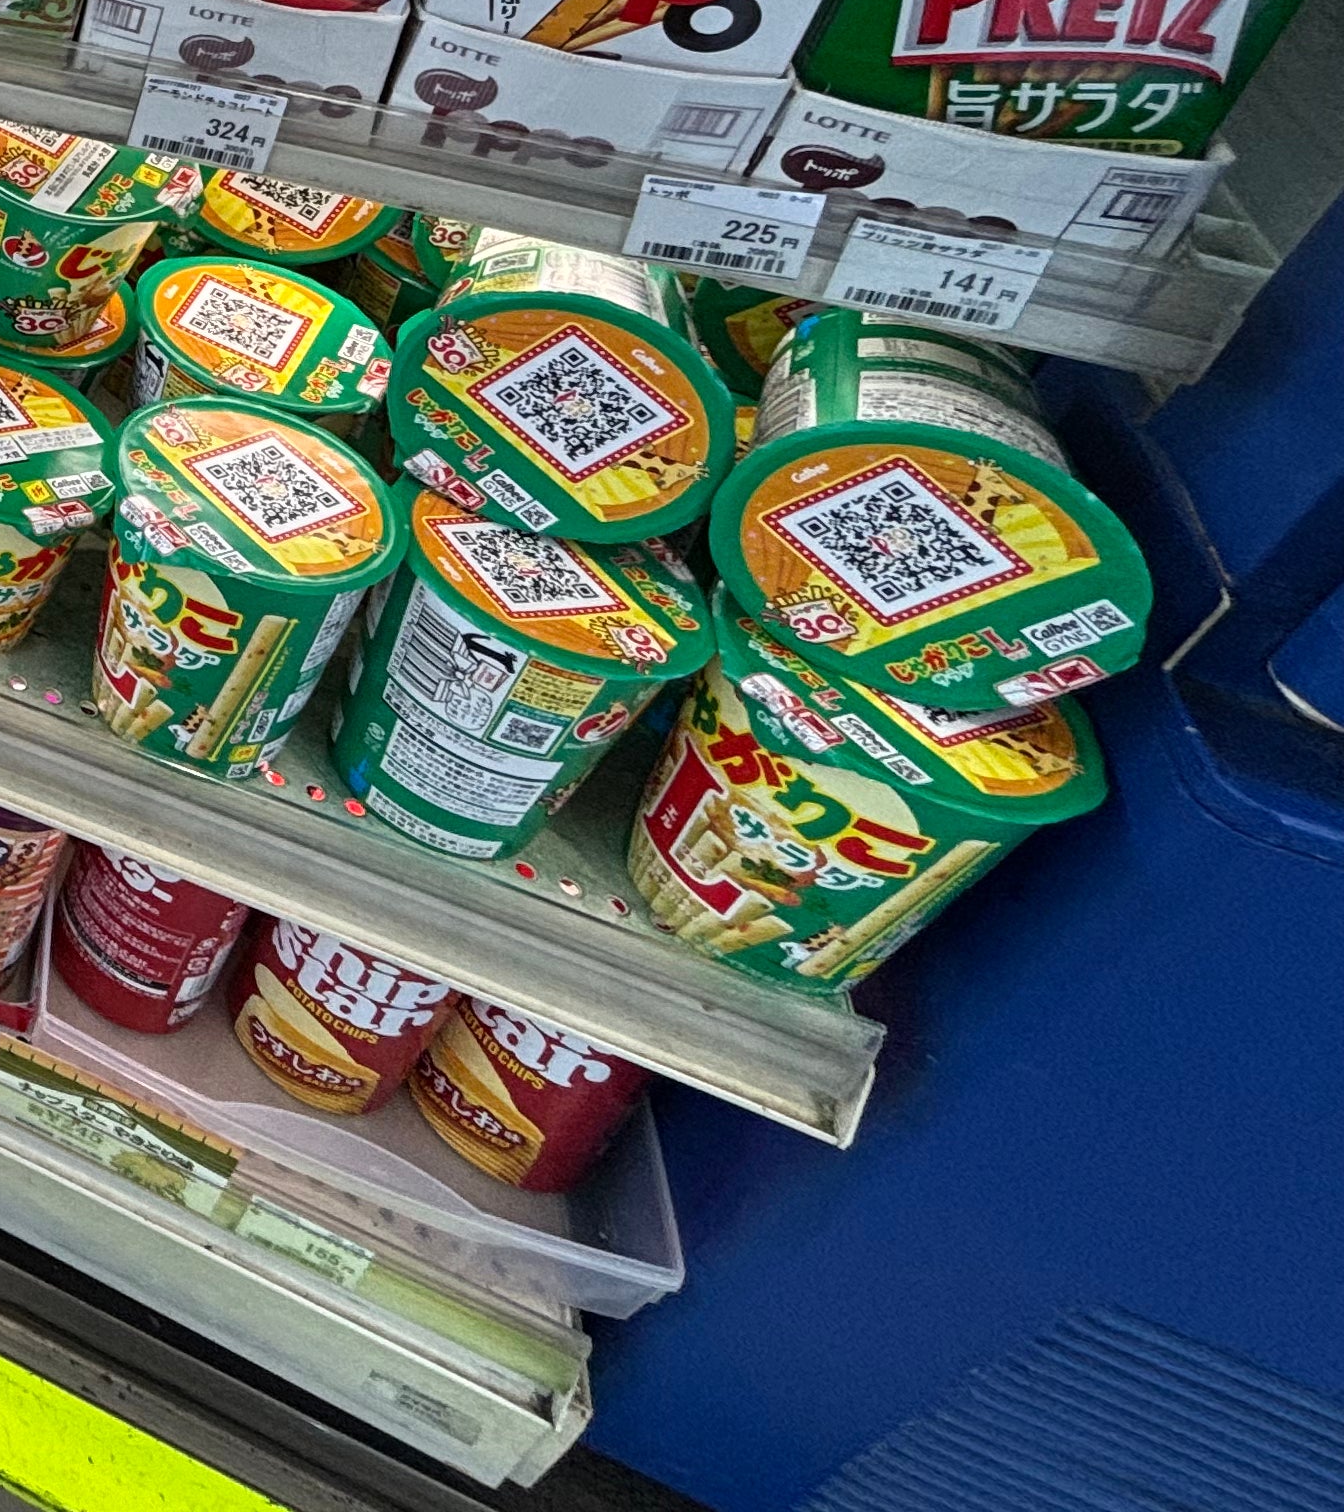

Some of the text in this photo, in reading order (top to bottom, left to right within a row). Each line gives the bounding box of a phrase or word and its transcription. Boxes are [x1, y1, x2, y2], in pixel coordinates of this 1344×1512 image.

[946, 79, 1205, 134] 旨サラダ
[205, 116, 266, 147] 324円
[719, 218, 799, 250] 225円
[937, 267, 1019, 305] 141円
[119, 598, 222, 670] サラダ
[728, 801, 886, 893] サラダ
